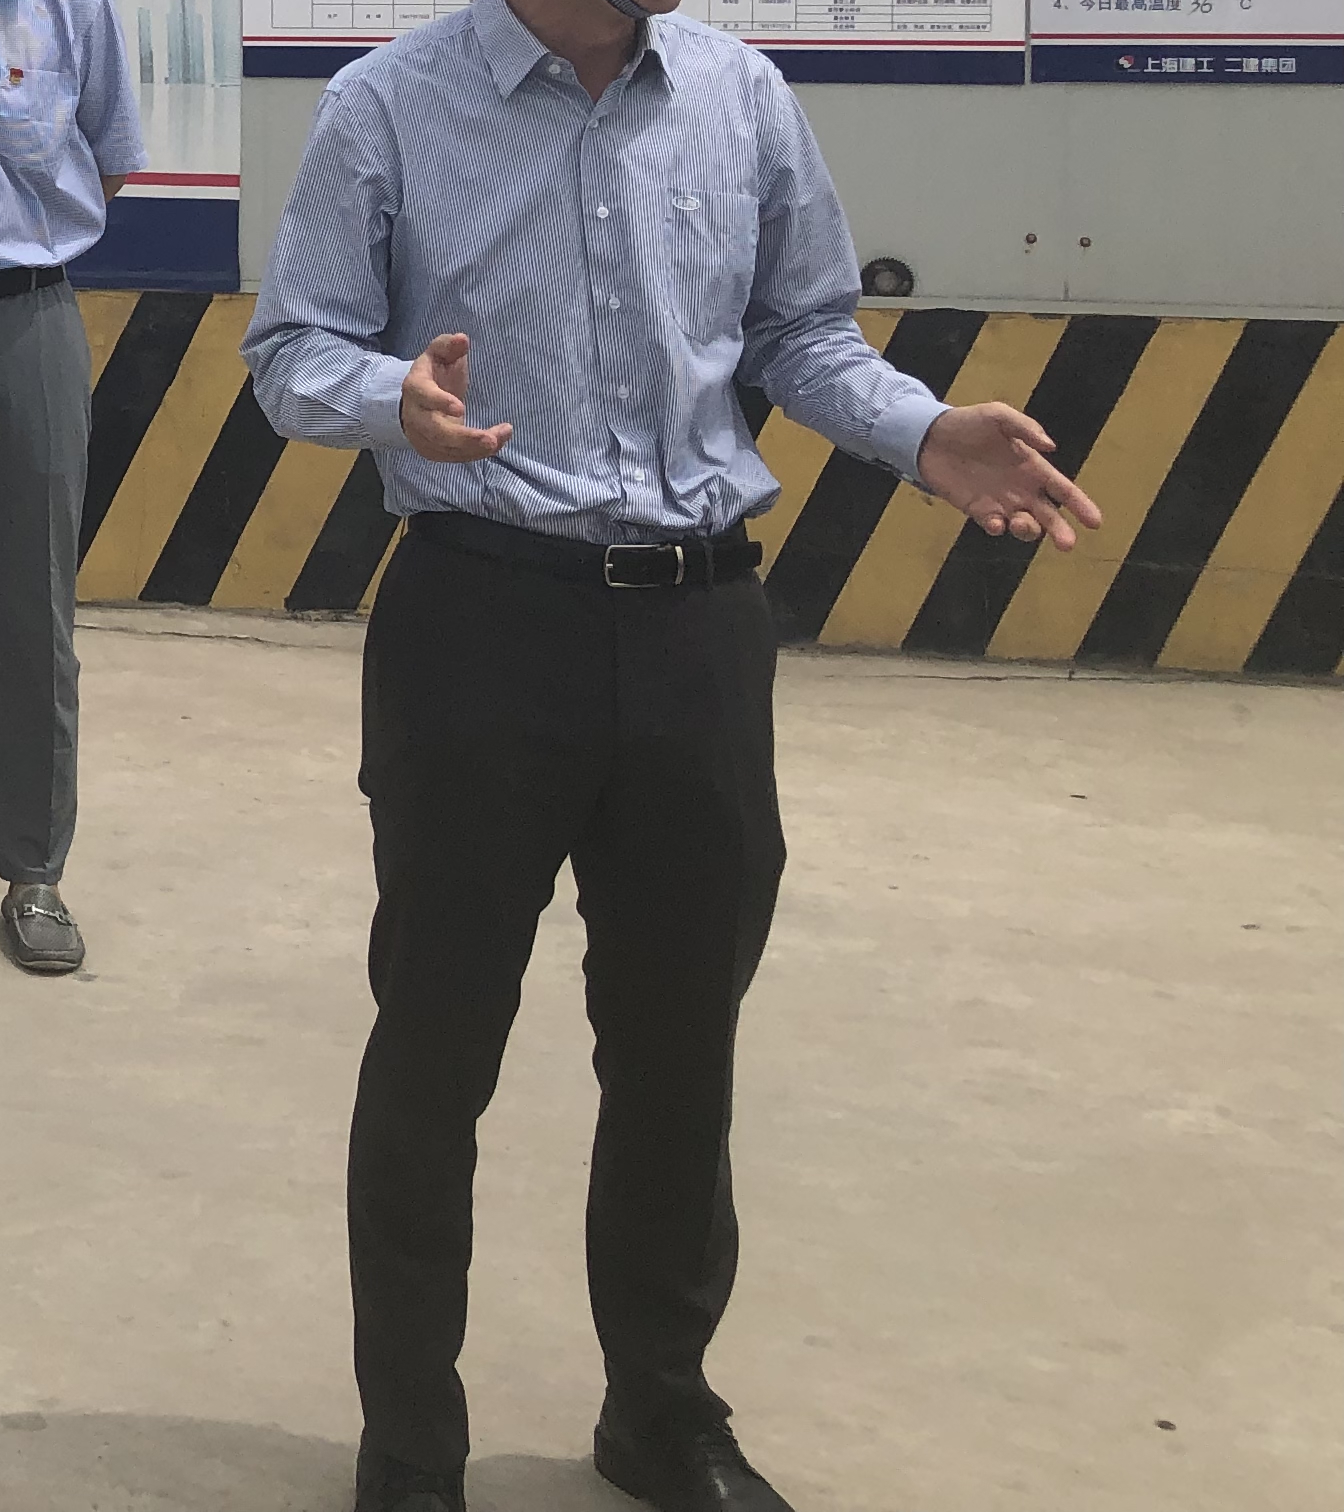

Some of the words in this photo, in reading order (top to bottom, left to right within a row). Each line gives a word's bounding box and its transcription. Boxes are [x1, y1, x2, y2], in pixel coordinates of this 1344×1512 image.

[1143, 57, 1214, 73] 上海建工
[1224, 57, 1296, 73] 二建集团
